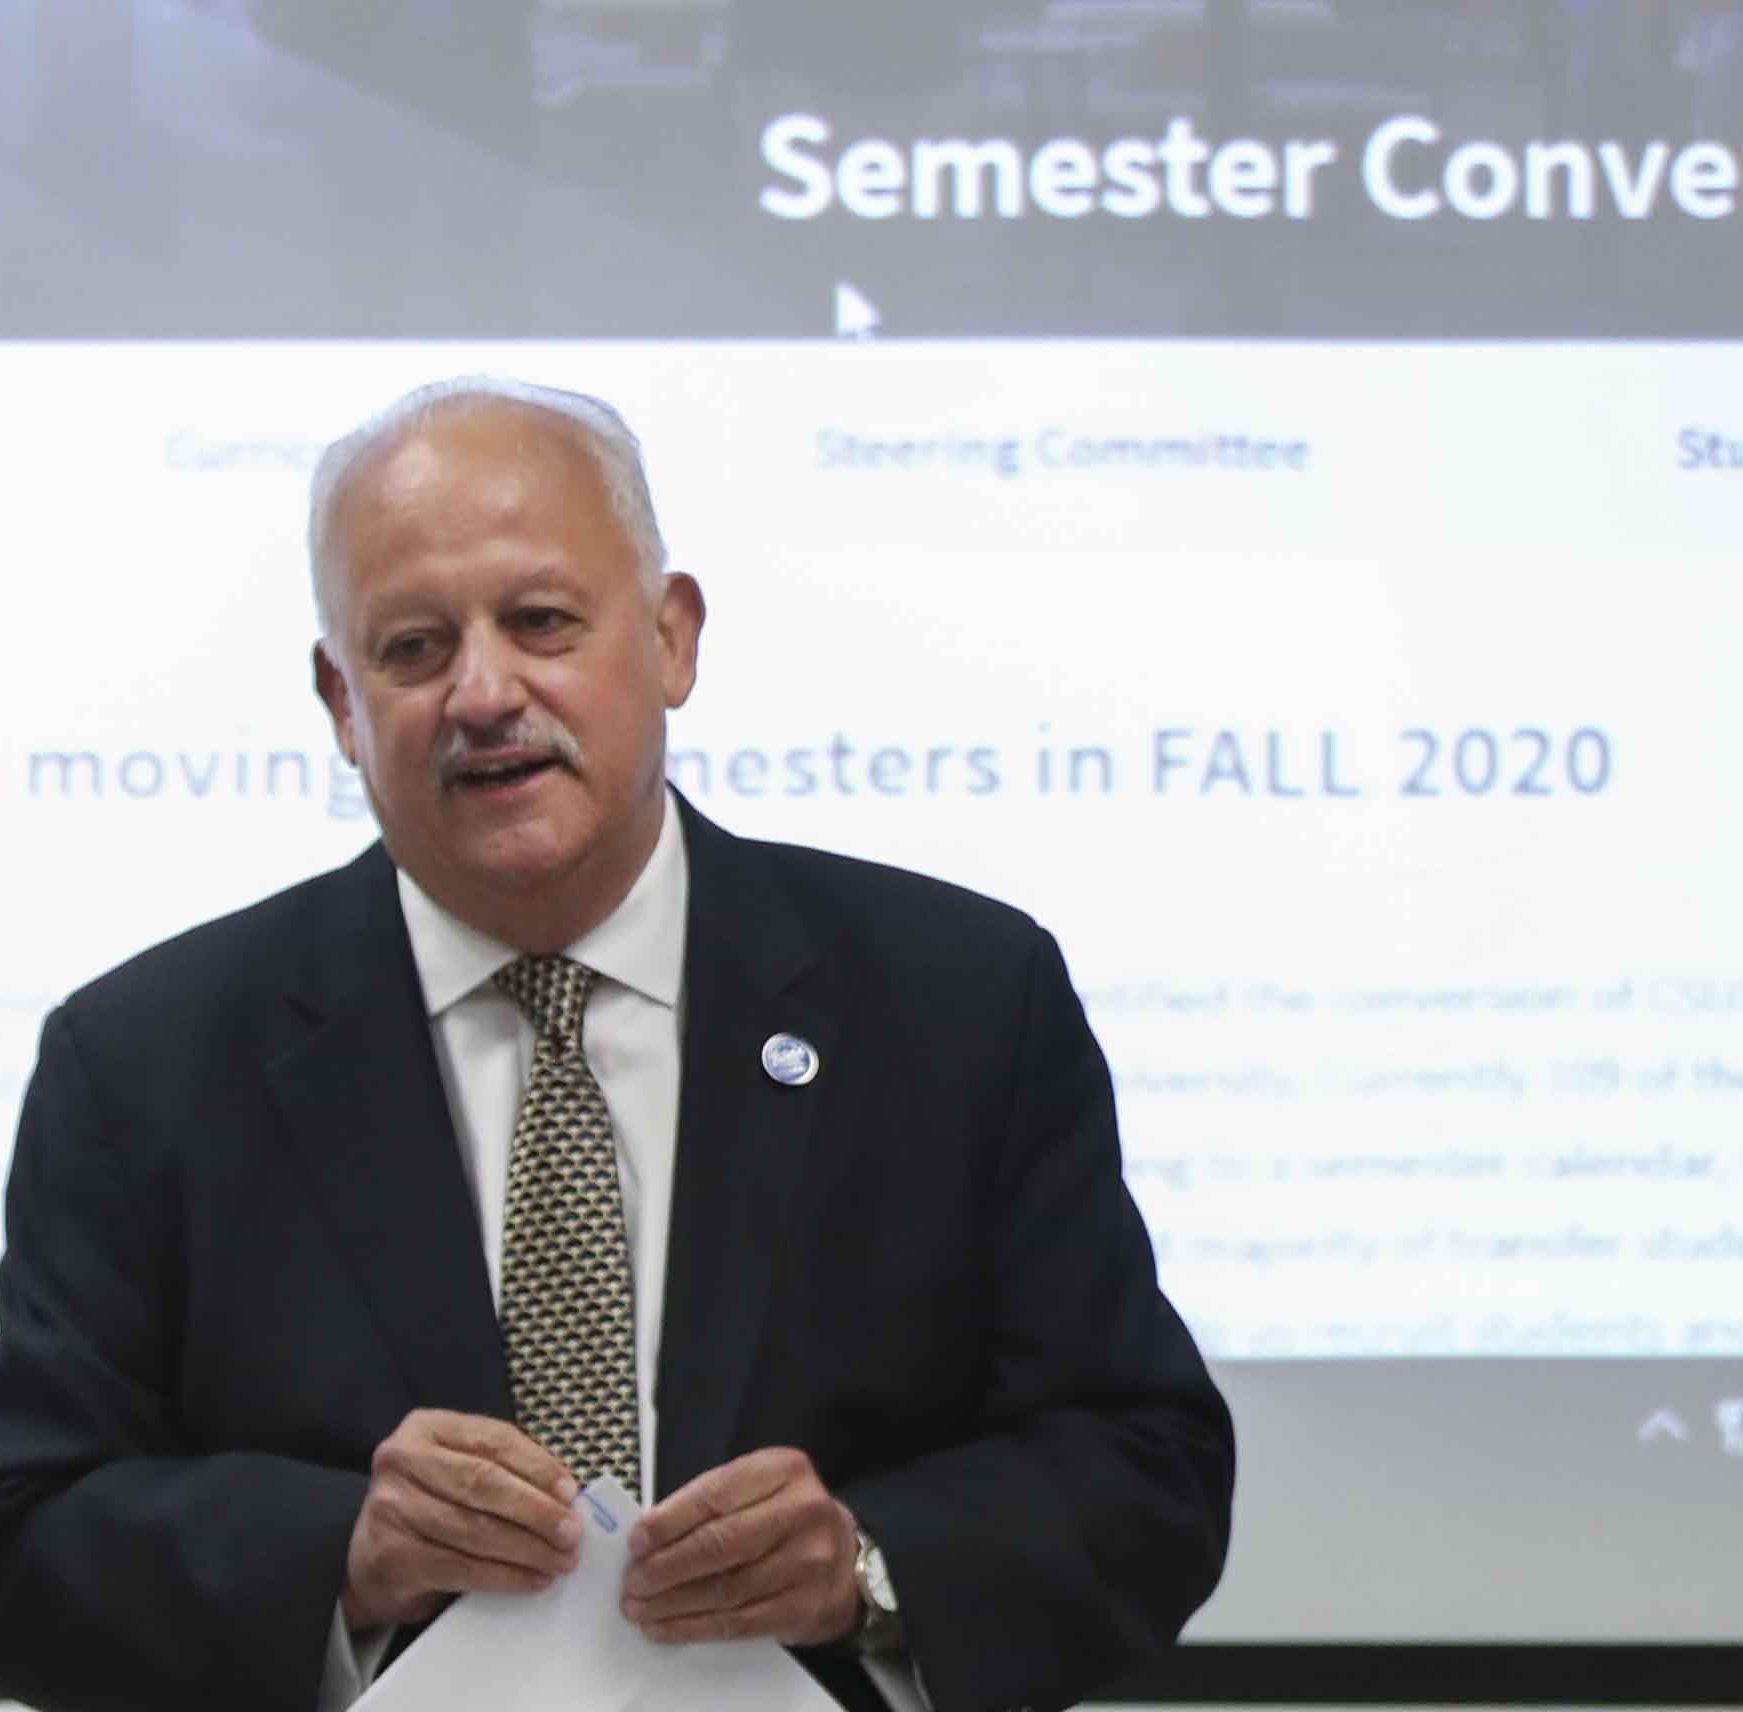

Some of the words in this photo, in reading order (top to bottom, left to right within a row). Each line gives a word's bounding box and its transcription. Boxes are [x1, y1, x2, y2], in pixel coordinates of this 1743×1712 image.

[758, 112, 1337, 221] Semester
[1361, 113, 1740, 222] Conve
[816, 427, 1023, 480] Steering
[1037, 427, 1313, 472] Committee
[1035, 724, 1117, 796] in
[1152, 727, 1363, 799] FALL
[1398, 726, 1614, 798] 2020
